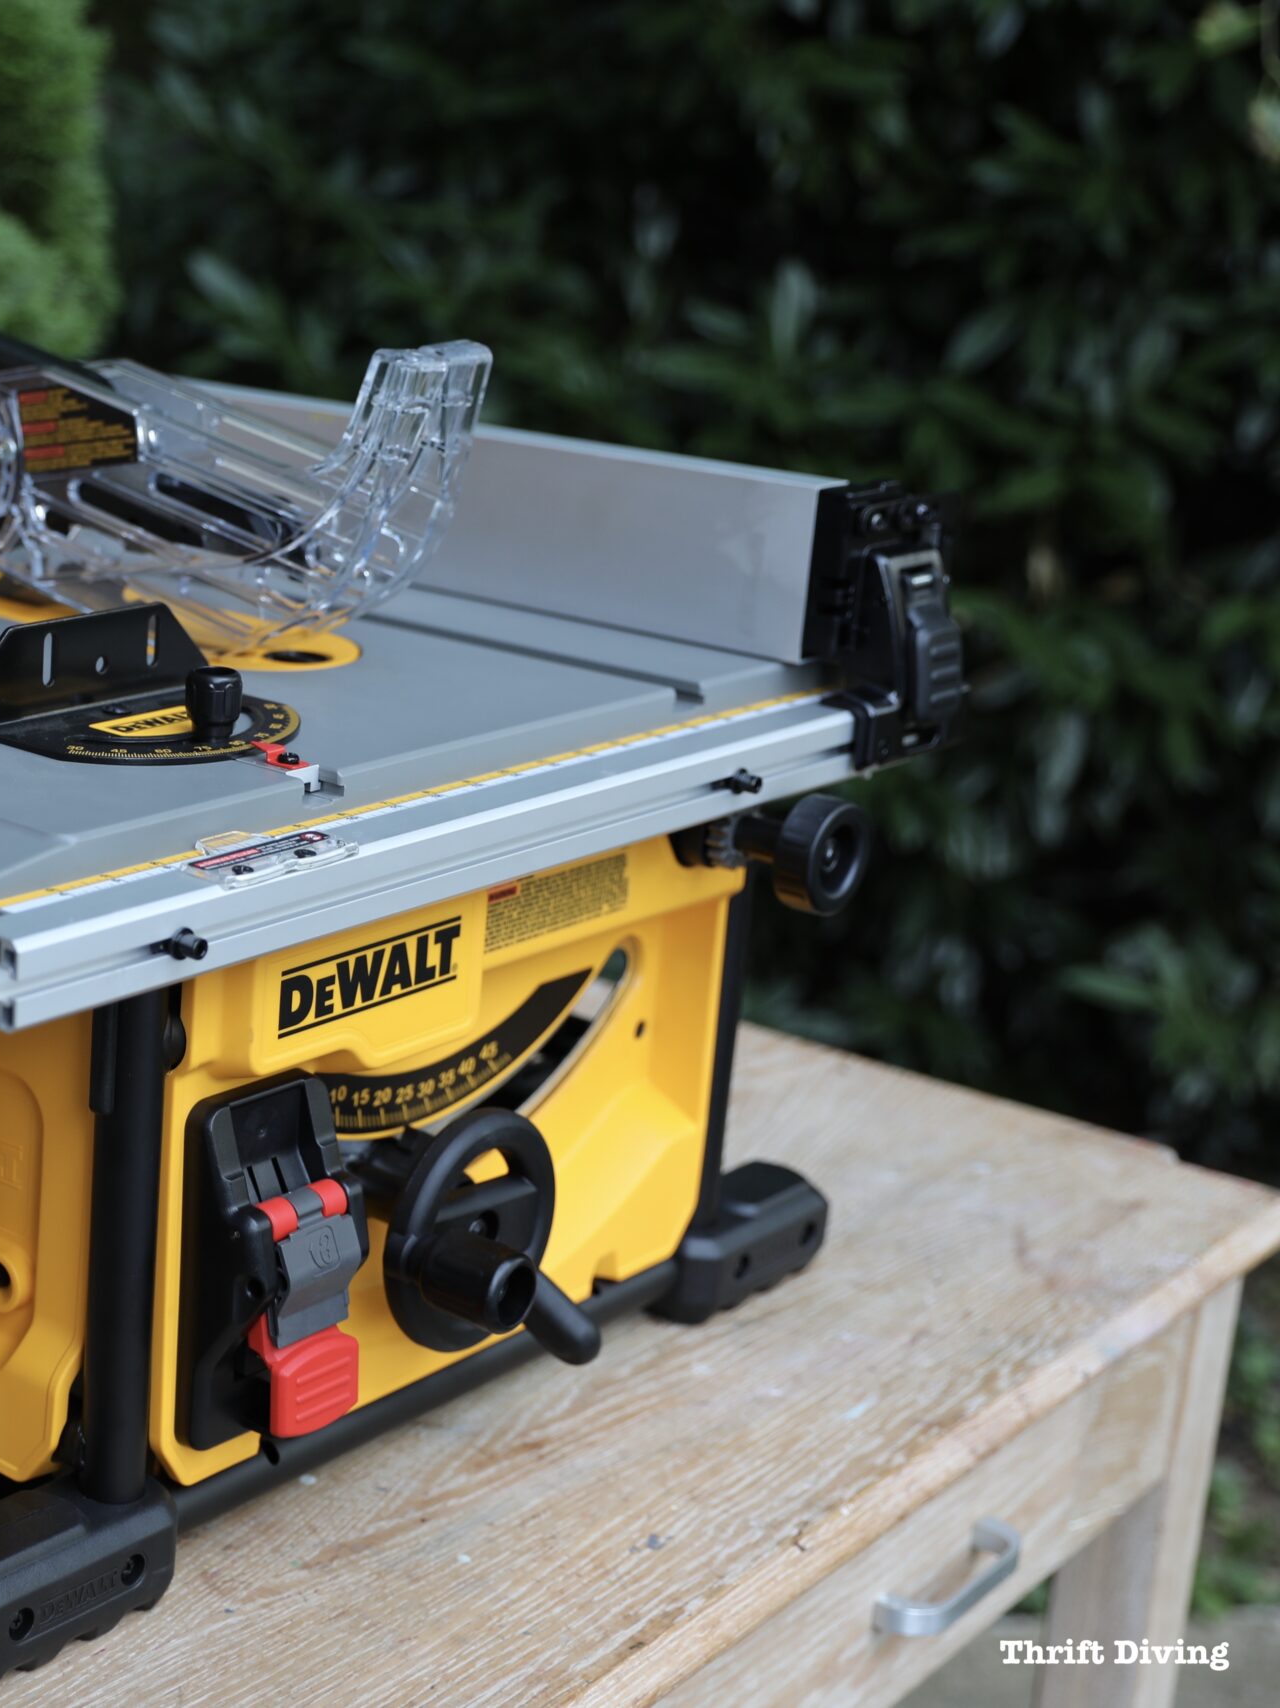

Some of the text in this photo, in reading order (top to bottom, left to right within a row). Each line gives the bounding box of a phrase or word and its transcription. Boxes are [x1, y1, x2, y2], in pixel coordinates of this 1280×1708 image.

[111, 711, 190, 732] DEWAL
[330, 1040, 499, 1108] 10 15 20 25 30 35 40 45
